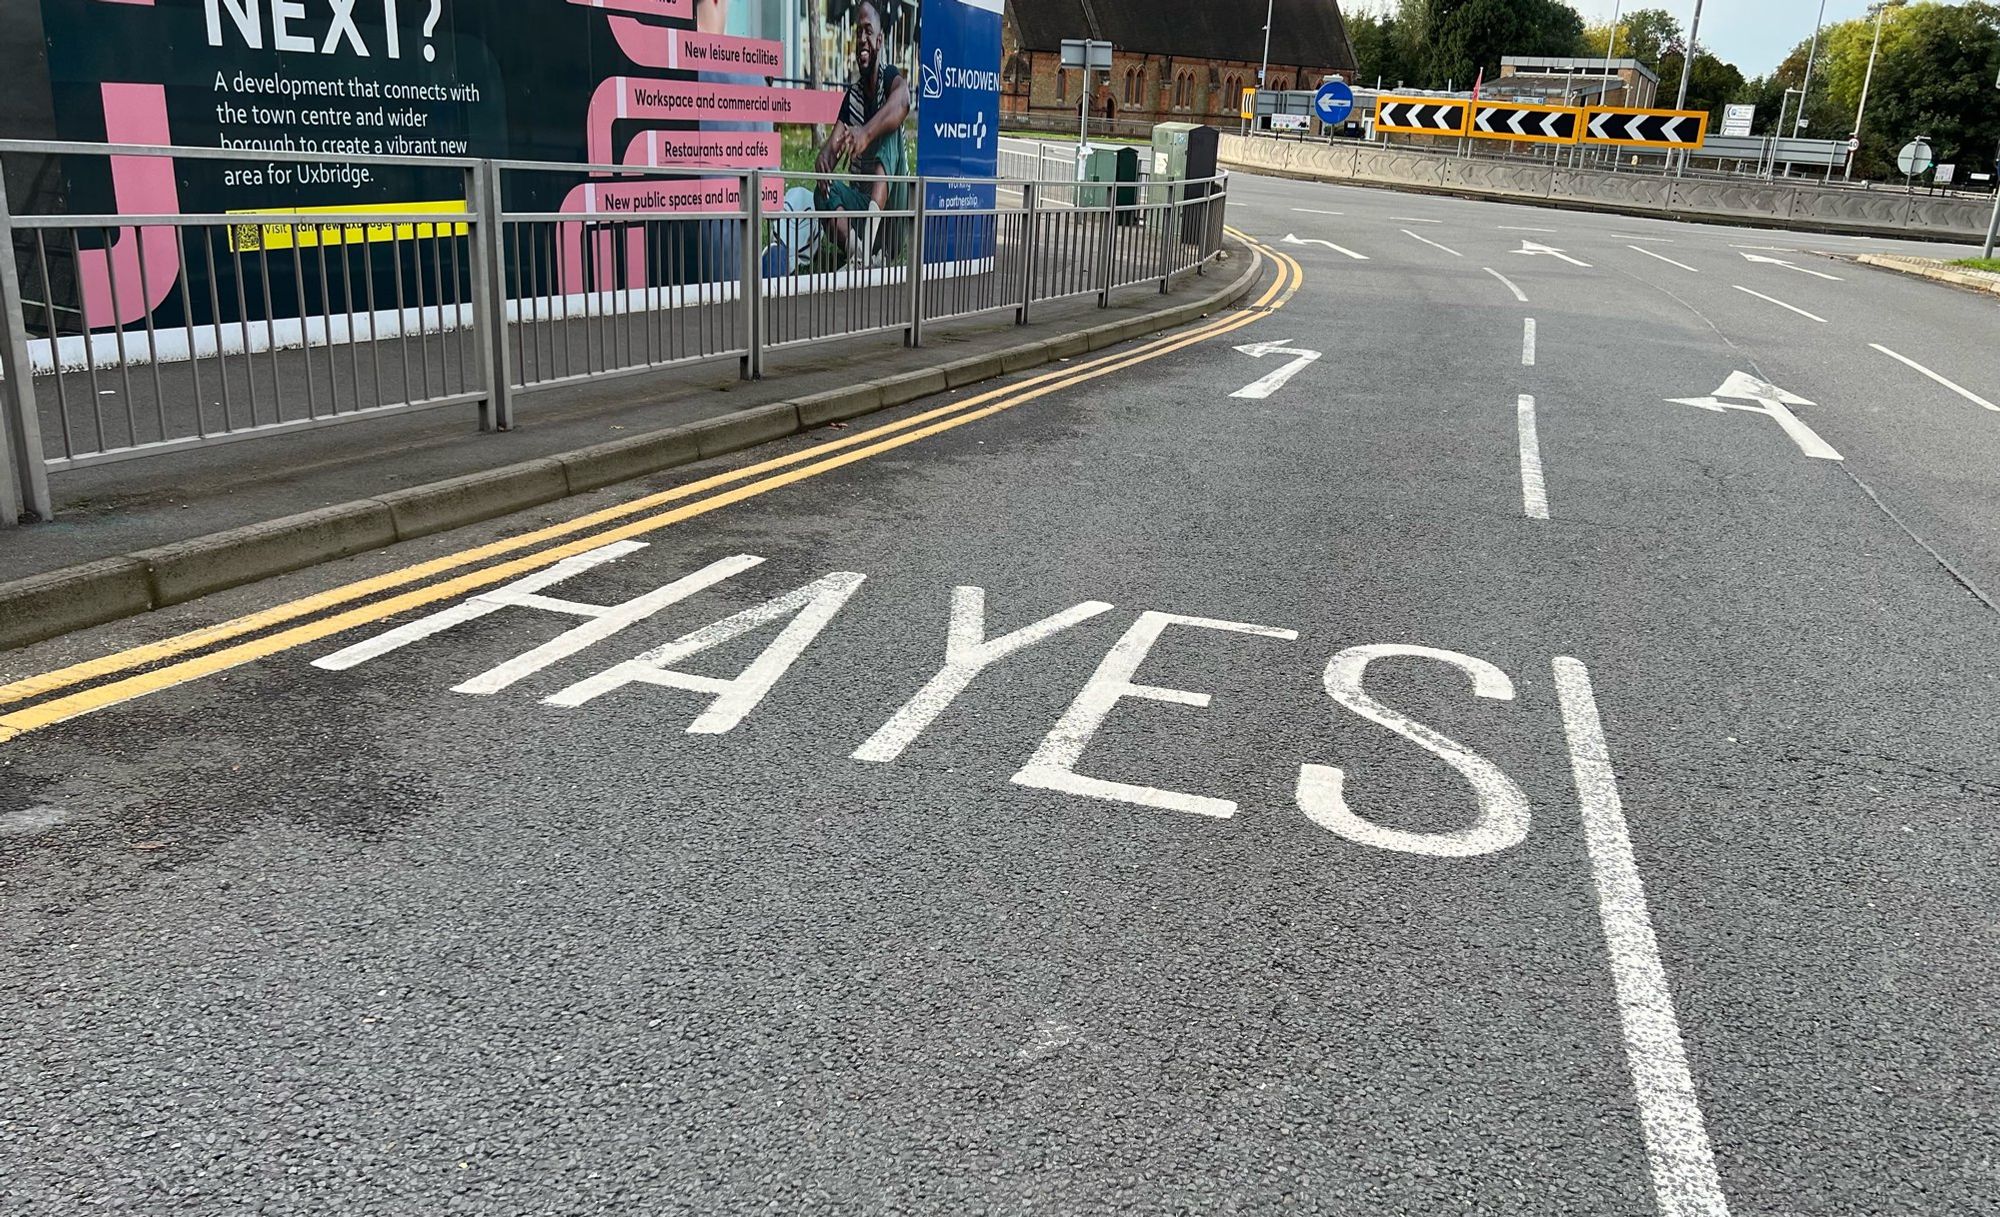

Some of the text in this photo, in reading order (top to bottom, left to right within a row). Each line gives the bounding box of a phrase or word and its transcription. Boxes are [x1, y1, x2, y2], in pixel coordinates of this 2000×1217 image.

[684, 41, 779, 67] New leisure facilities
[214, 70, 480, 102] A development that connects with
[634, 88, 792, 112] Workspace and commercial units
[216, 101, 428, 127] the town centre and wider
[934, 123, 971, 139] VINCI
[300, 136, 317, 153] to
[322, 135, 370, 154] create
[374, 138, 383, 154] a
[387, 134, 437, 154] vibrant
[440, 139, 467, 154] new
[664, 141, 769, 158] Restaurants and cafés
[224, 161, 374, 188] area for Uxbridge.
[605, 193, 631, 211] New
[633, 191, 666, 212] public
[668, 193, 703, 211] spaces
[704, 188, 724, 206] and
[938, 193, 979, 210] in partnership
[311, 540, 1531, 859] HAYES
